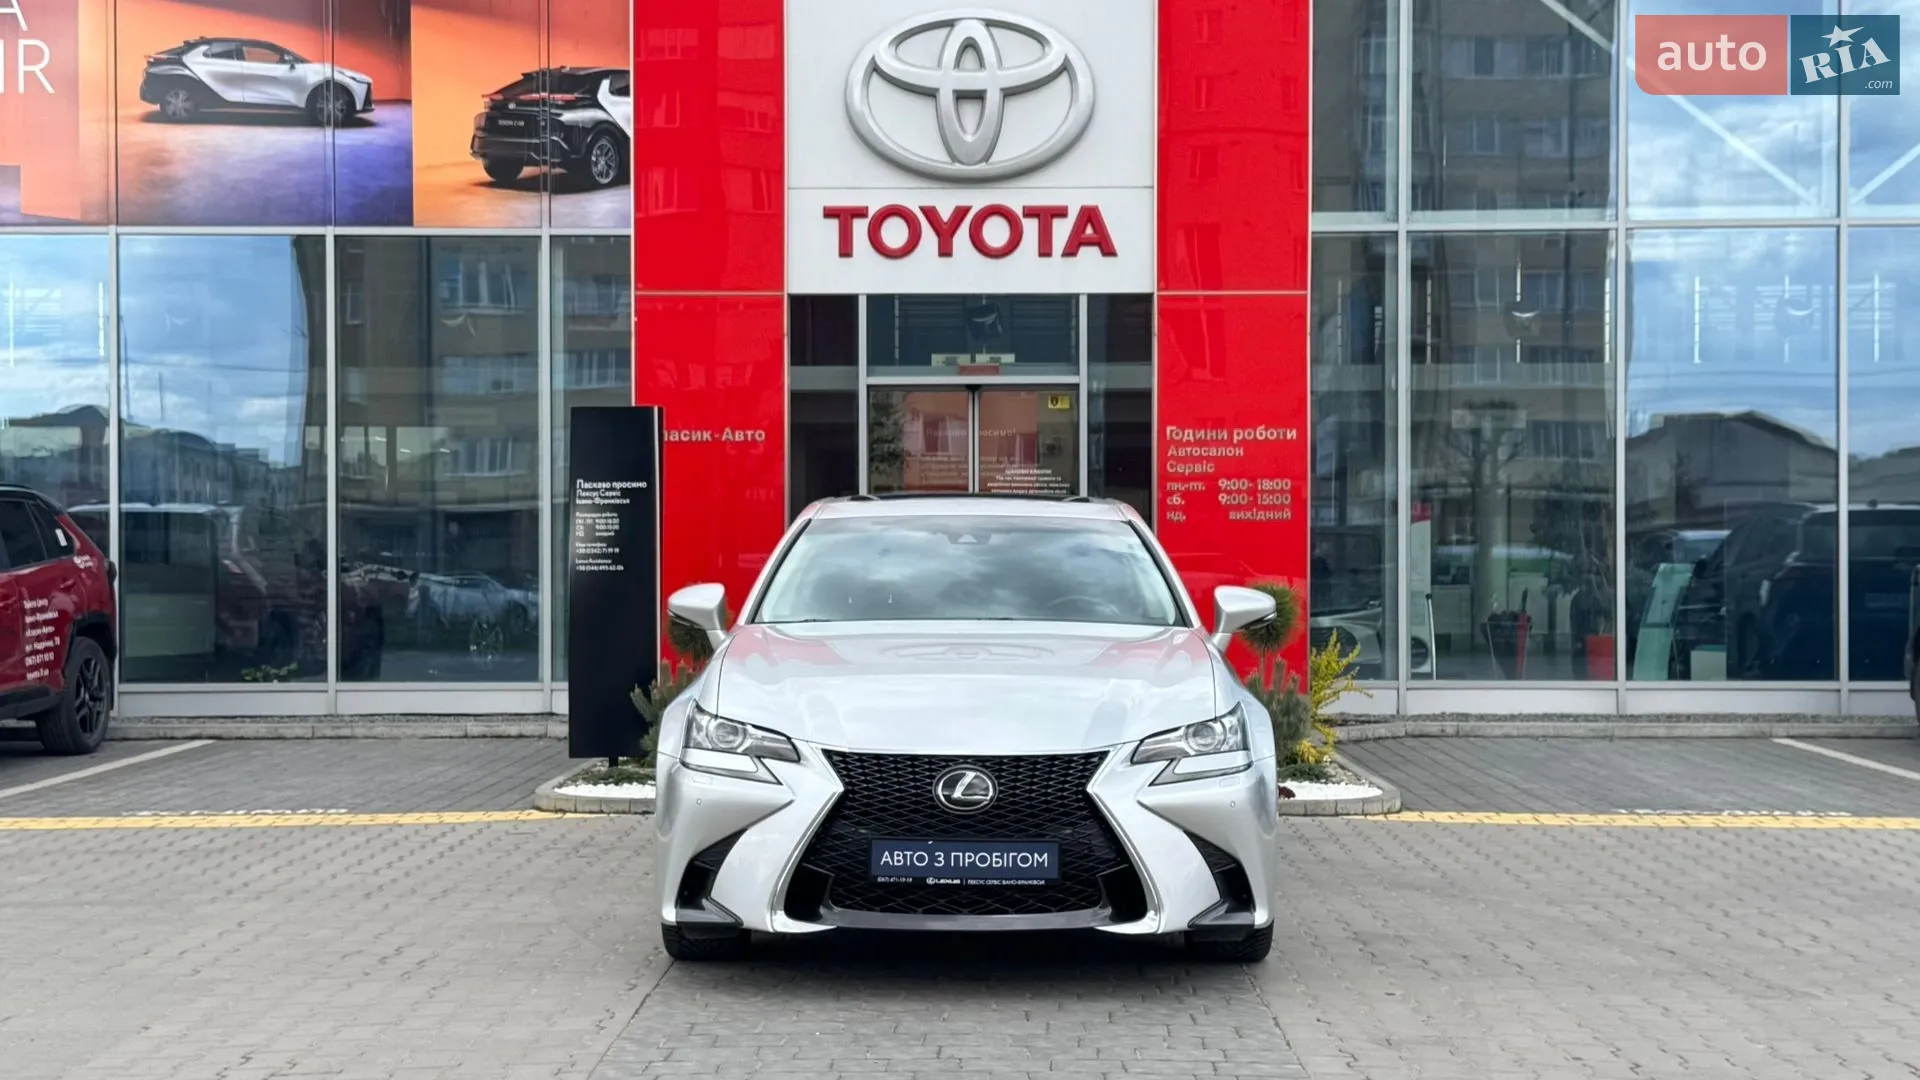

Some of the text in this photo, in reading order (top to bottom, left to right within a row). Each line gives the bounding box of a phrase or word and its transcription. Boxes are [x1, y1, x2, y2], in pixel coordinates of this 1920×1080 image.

[822, 203, 1118, 259] TOYOTA
[1166, 425, 1297, 443] Години роботи
[1167, 446, 1244, 457] Автосалон
[1166, 461, 1215, 476] Сервіс
[612, 481, 647, 490] просимо
[1166, 493, 1185, 505] сб.
[1166, 508, 1292, 522] нд. вихідний
[880, 851, 929, 867] АВТО
[951, 852, 1048, 868] ПРОБІГОМ
